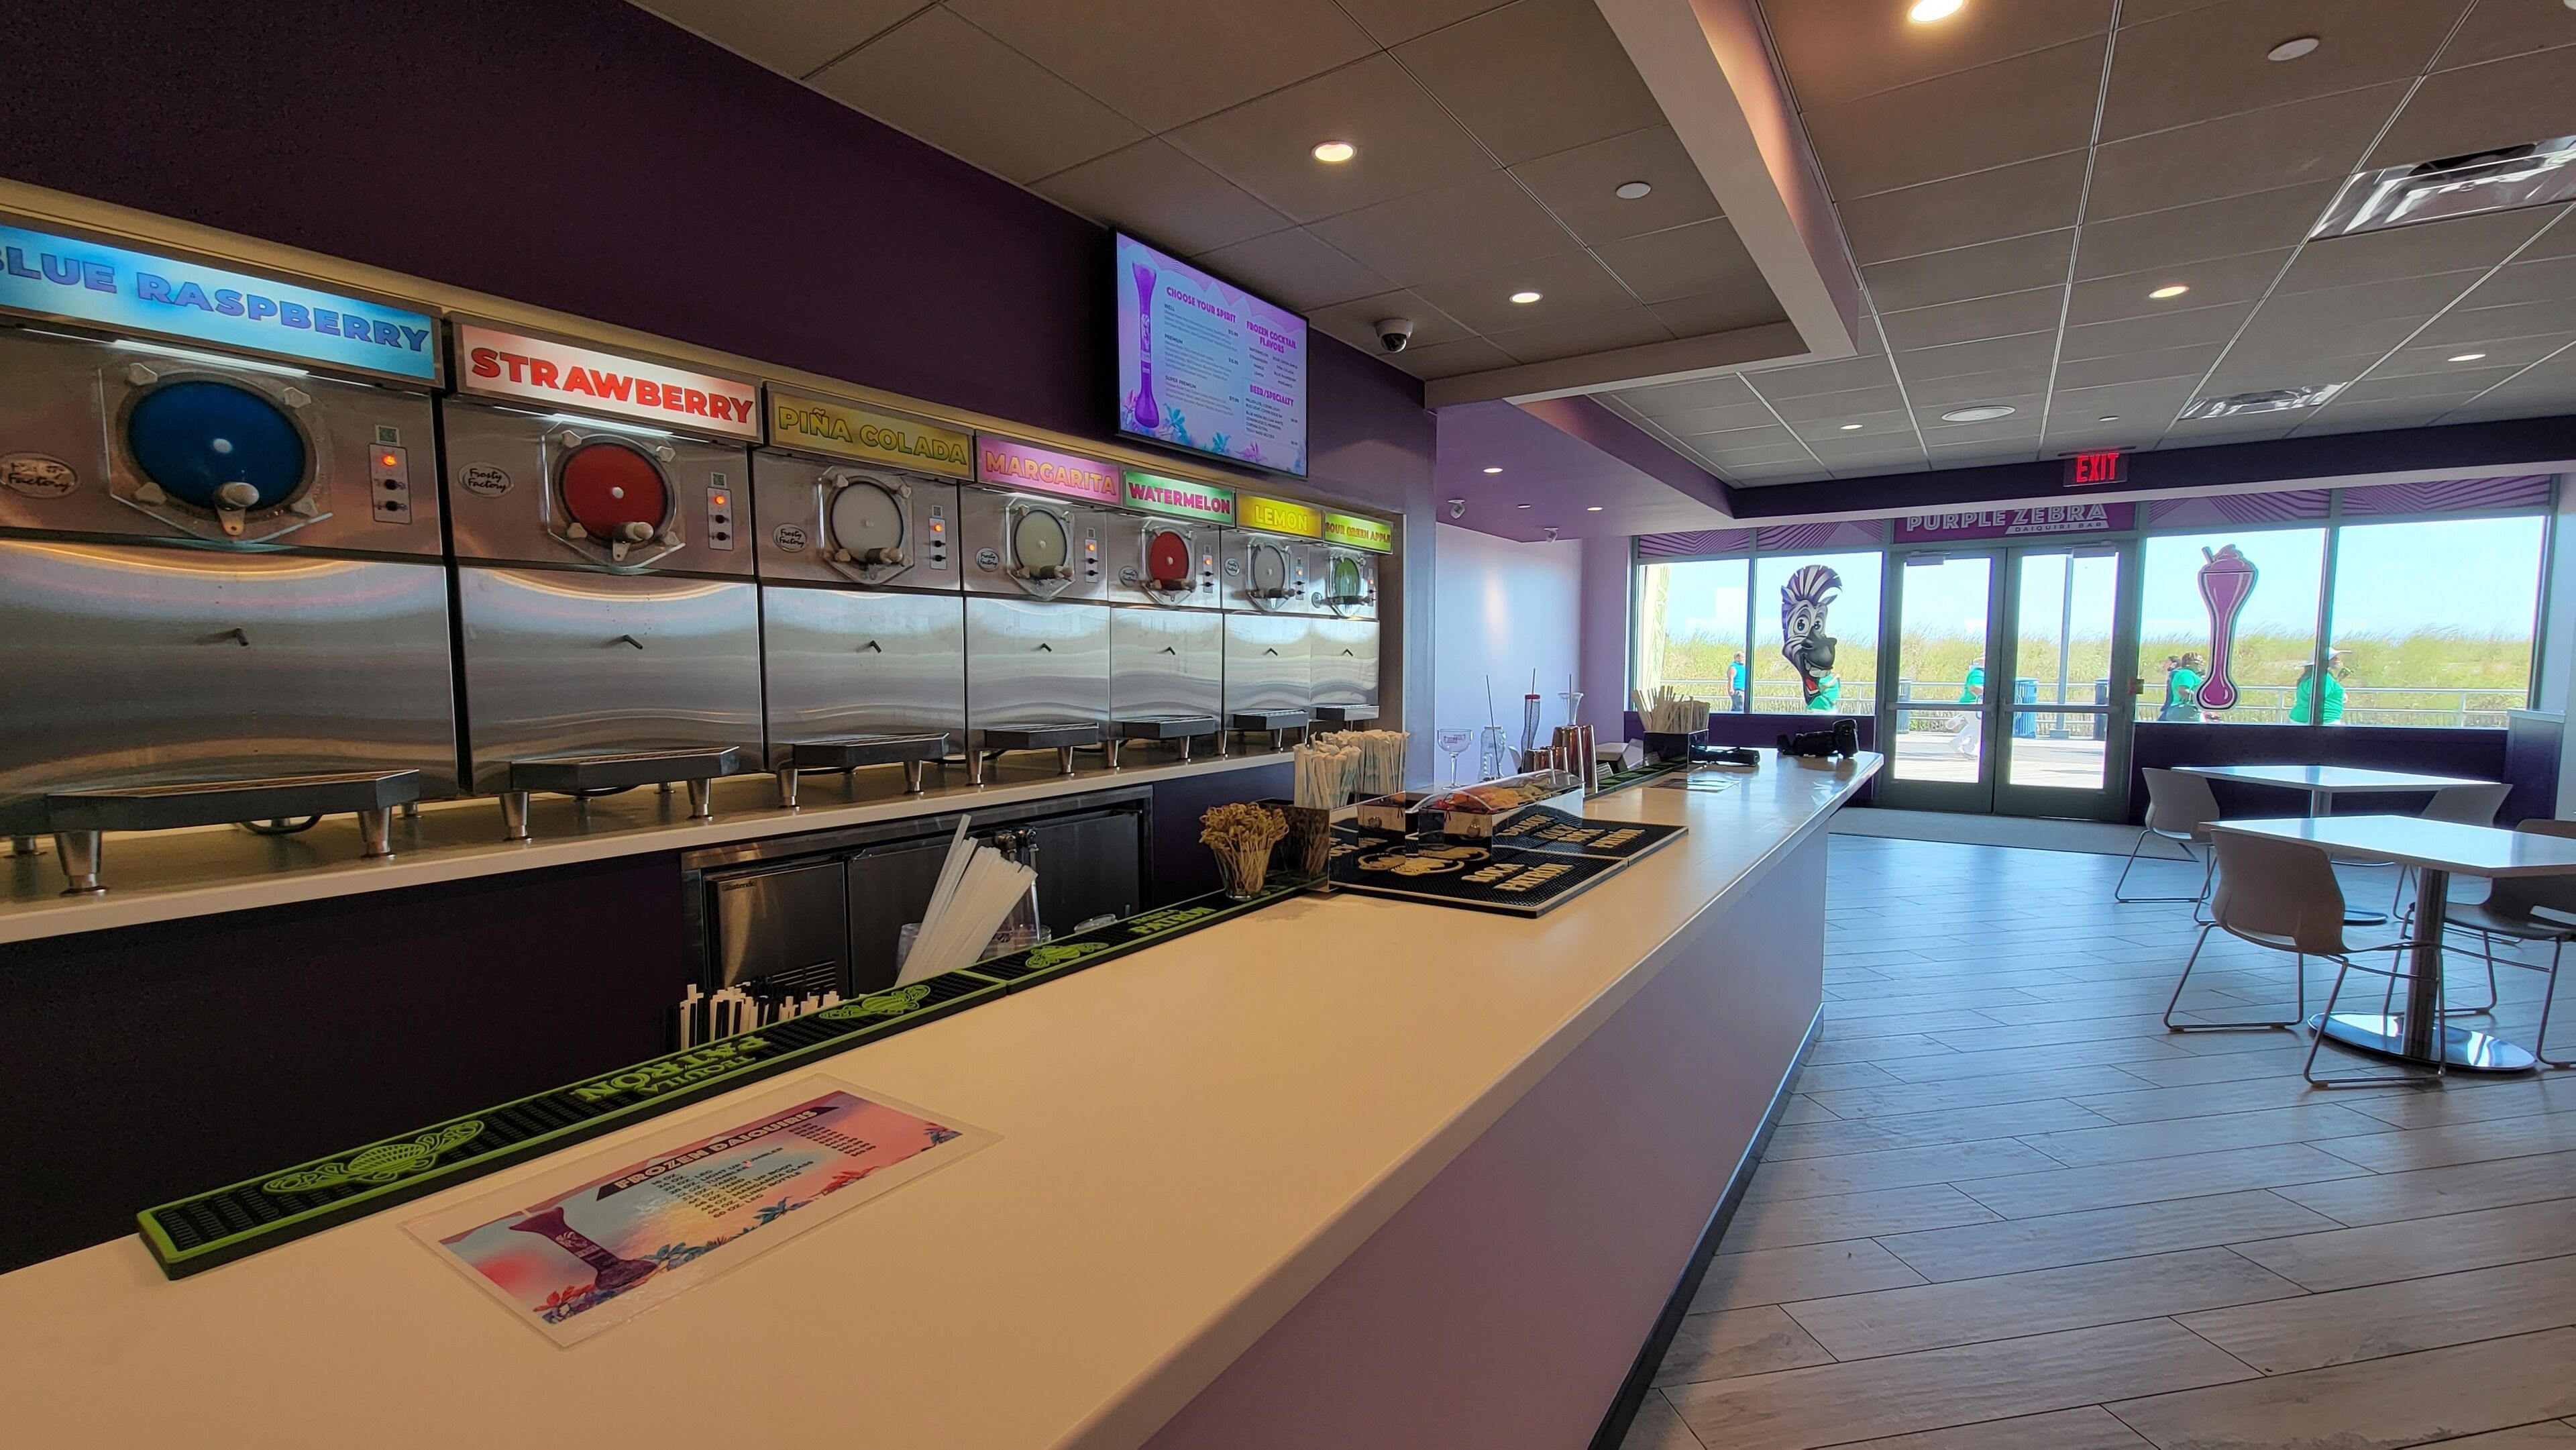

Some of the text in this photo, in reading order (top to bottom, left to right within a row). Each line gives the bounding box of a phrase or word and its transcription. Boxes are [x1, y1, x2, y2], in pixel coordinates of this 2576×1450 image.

[0, 246, 429, 352] LUE RASPBERRY
[1164, 303, 1175, 312] WELL
[1167, 286, 1236, 324] CHOOSE YOUR SPIRIT
[1246, 321, 1268, 338] FROZEN
[1269, 330, 1296, 349] COCKTAIL
[1260, 336, 1283, 354] FLAVORS
[471, 348, 753, 423] STRAWBERRY
[779, 407, 967, 466] PIÑA COLADA
[470, 468, 502, 482] Frosty
[985, 450, 1116, 495] MARGARITA
[2076, 452, 2119, 483] EXIT
[468, 478, 507, 493] Factory
[1128, 482, 1230, 515] WATERMELON
[1255, 505, 1308, 531] LEMON
[1907, 503, 2107, 531] PURPLE ZEBRA
[2015, 524, 2071, 532] DAIQUIRI
[1326, 522, 1391, 543] SOUR GREEN APPLE
[1461, 863, 1525, 882] ROCA
[613, 1110, 819, 1188] FROZEN DAIQUIRIS
